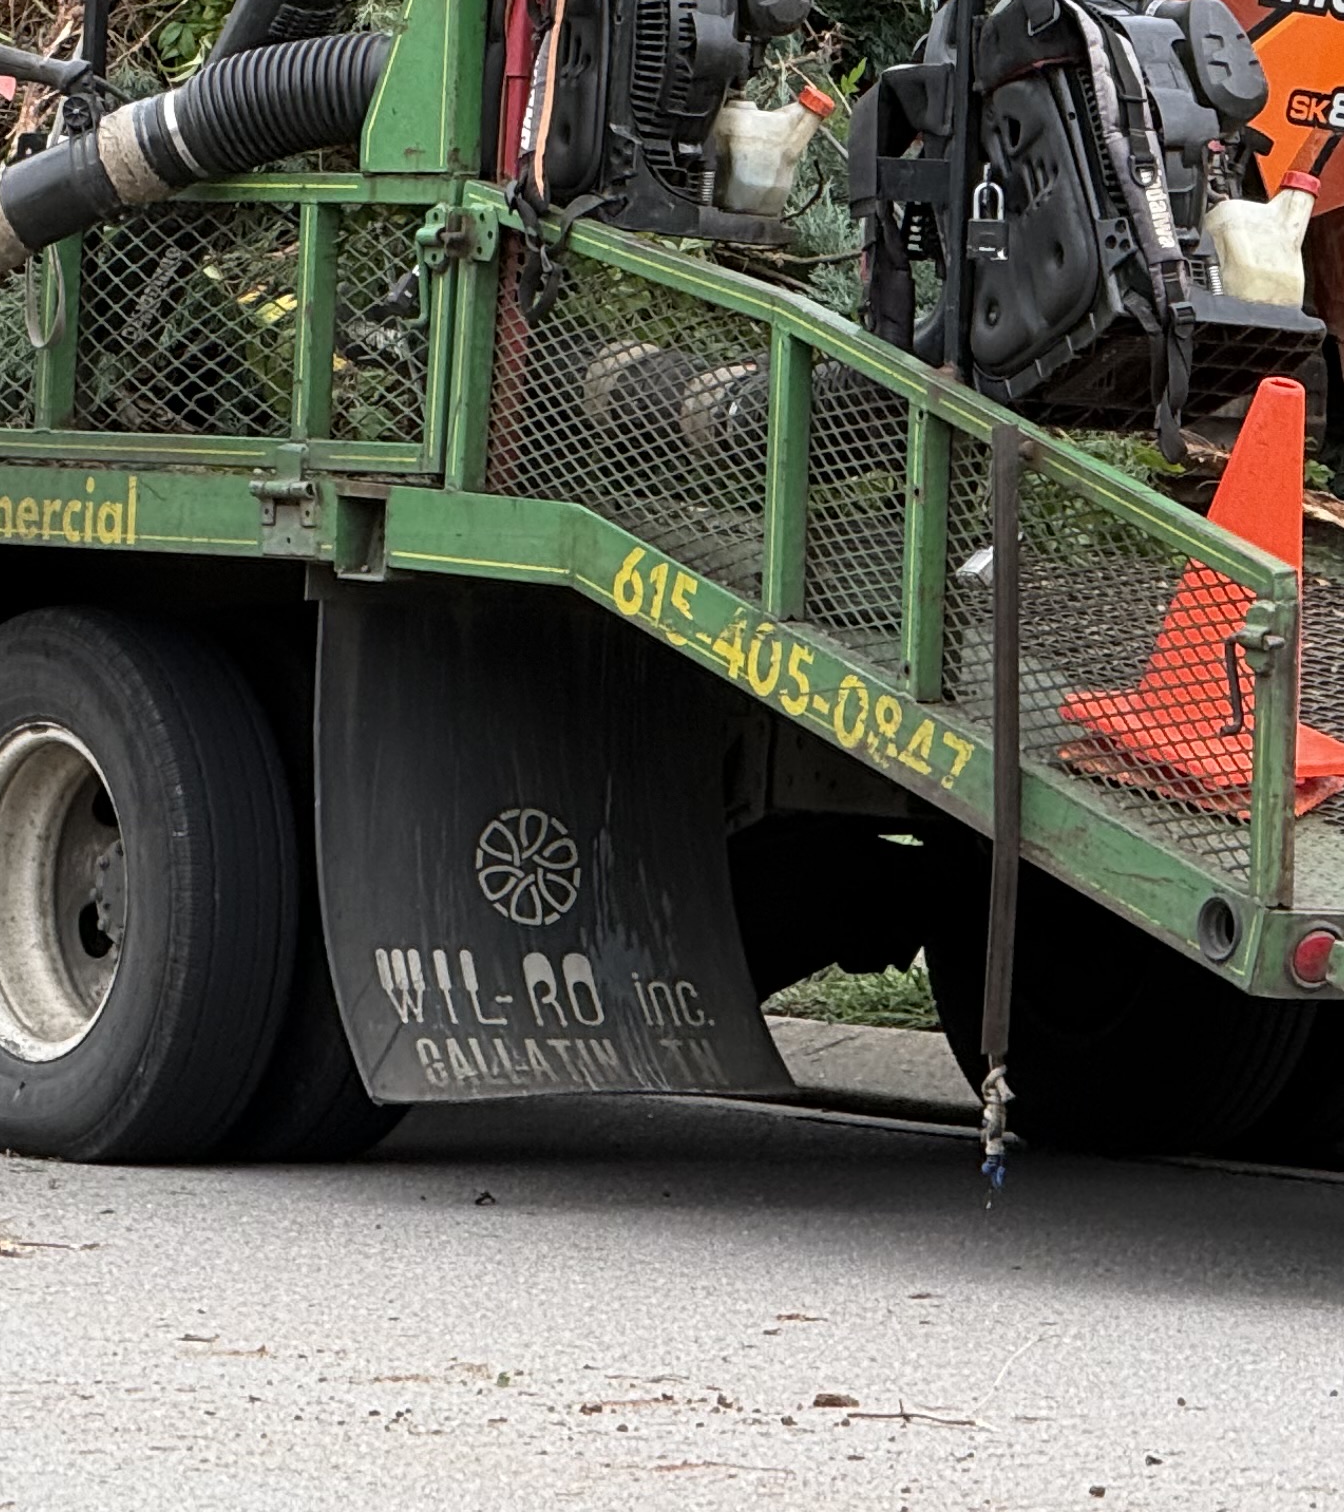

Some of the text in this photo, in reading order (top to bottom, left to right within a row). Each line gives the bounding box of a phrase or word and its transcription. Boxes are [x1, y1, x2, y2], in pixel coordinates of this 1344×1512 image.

[613, 546, 975, 790] 615-405-0847
[374, 948, 716, 1028] WIL-RO inc.
[415, 1038, 623, 1088] GALLATIN
